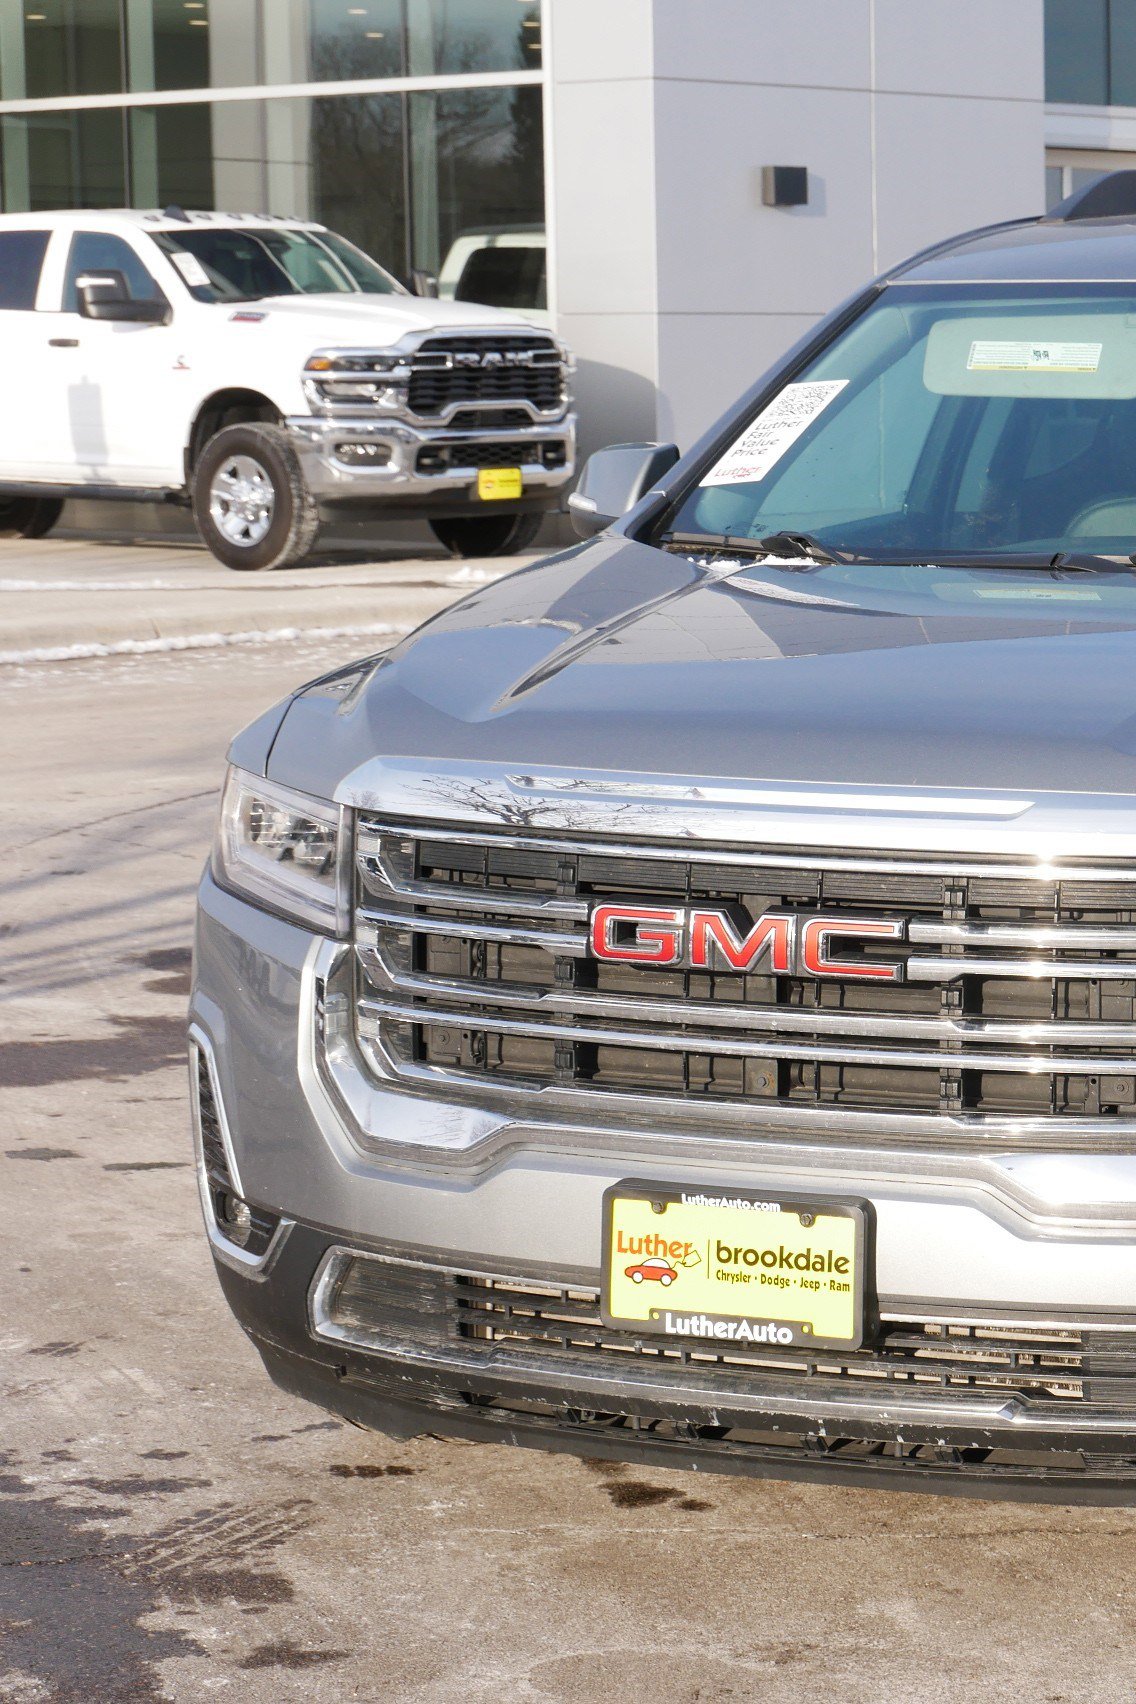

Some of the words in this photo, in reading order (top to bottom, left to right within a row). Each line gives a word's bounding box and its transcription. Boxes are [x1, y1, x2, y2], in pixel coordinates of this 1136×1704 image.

[453, 351, 534, 369] RAM
[755, 420, 803, 431] Luther
[590, 903, 906, 983] GMC
[681, 1193, 782, 1213] LutherAuto.com
[617, 1230, 693, 1259] Luther
[716, 1239, 851, 1275] brookdale
[716, 1269, 752, 1285] Chrysler
[760, 1273, 791, 1289] Dodge
[800, 1277, 821, 1292] Jeep
[829, 1279, 851, 1292] Ram
[665, 1312, 794, 1345] LutherAuto
